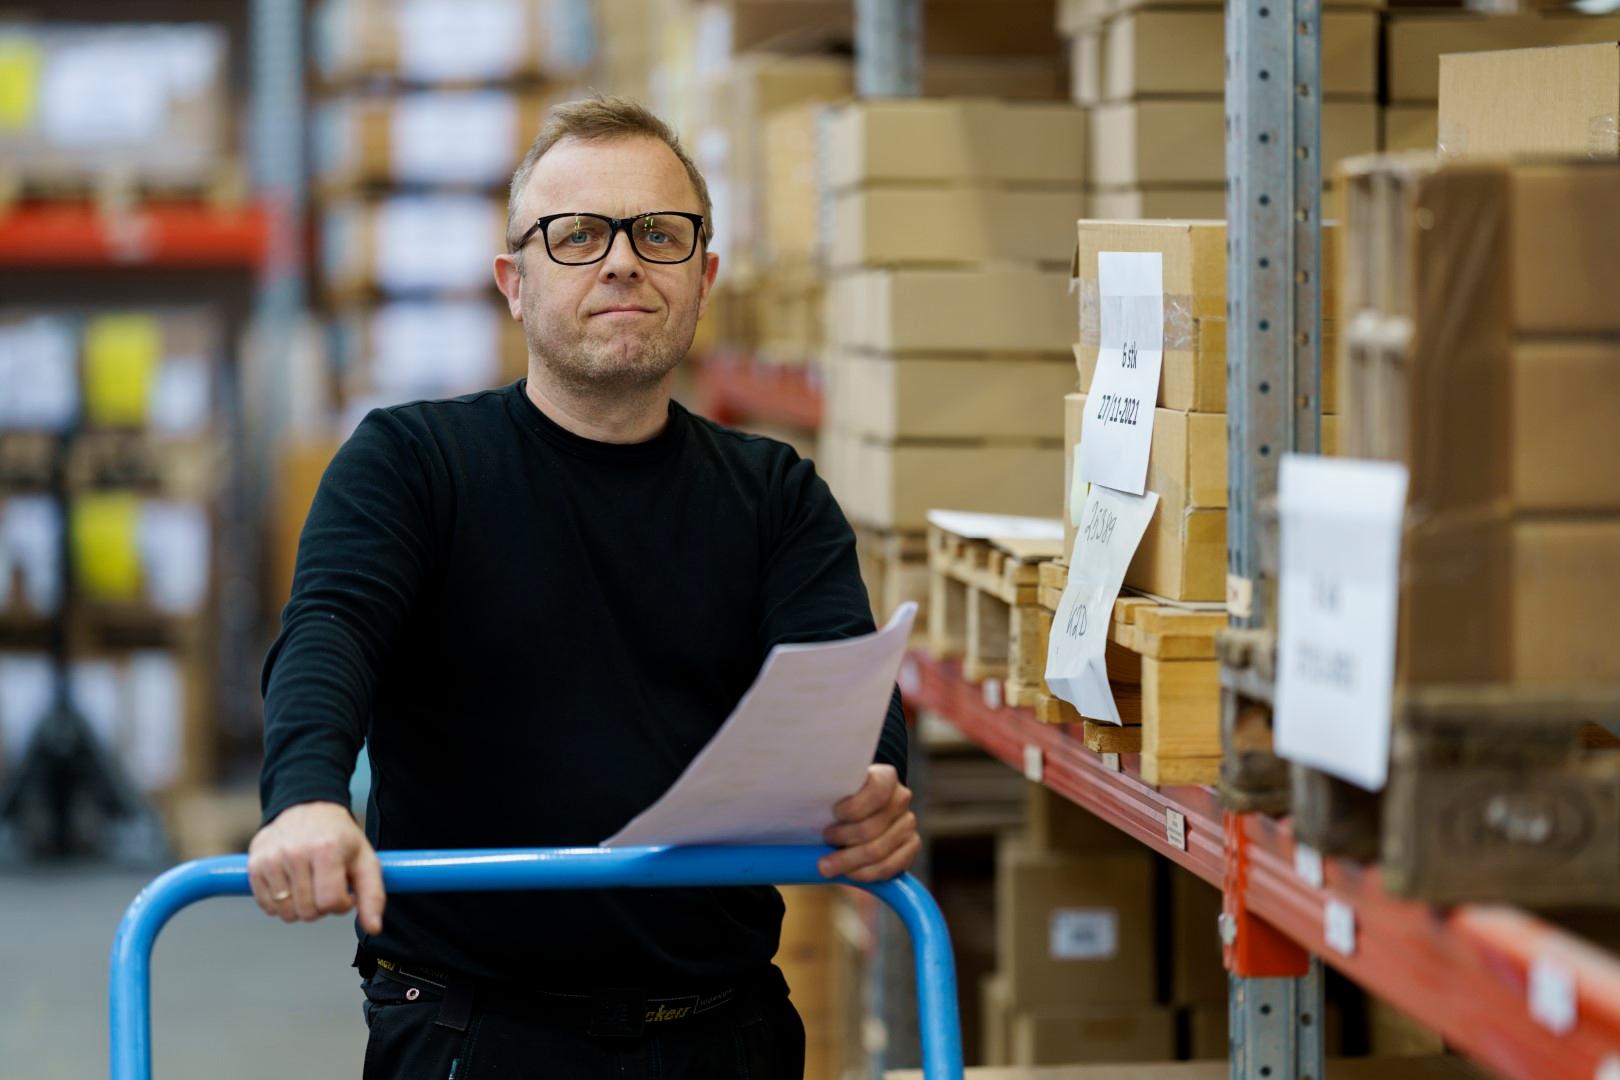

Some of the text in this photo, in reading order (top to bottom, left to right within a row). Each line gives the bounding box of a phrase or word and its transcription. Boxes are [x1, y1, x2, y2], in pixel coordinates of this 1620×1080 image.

[1121, 341, 1138, 369] 6 stk
[1097, 393, 1140, 427] 27/11-2021
